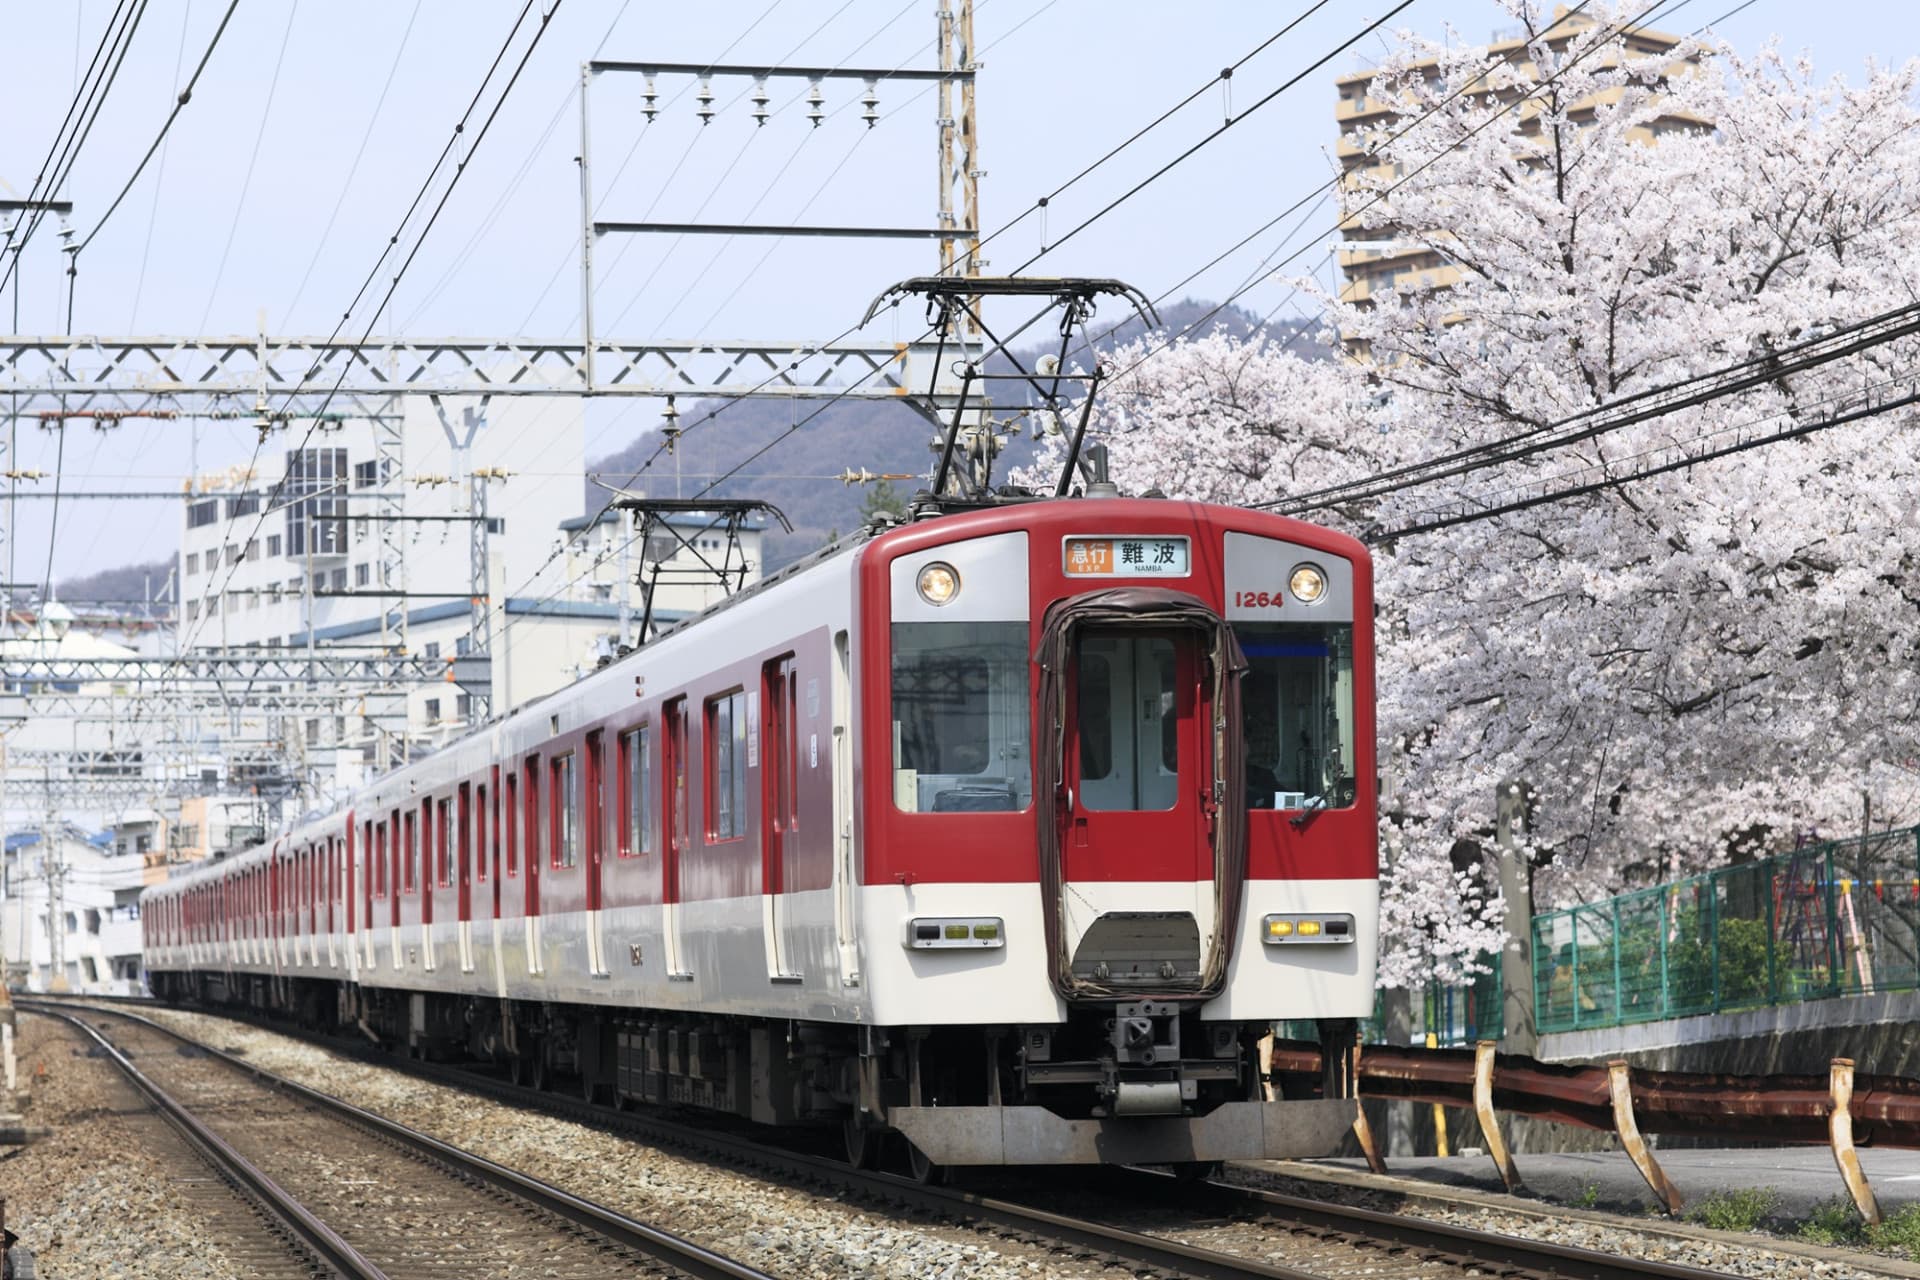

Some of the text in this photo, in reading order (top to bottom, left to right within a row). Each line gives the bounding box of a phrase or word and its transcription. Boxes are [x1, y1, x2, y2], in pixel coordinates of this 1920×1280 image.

[1071, 543, 1107, 564] 急行
[1121, 542, 1175, 564] 難波
[1236, 591, 1284, 608] 1264
